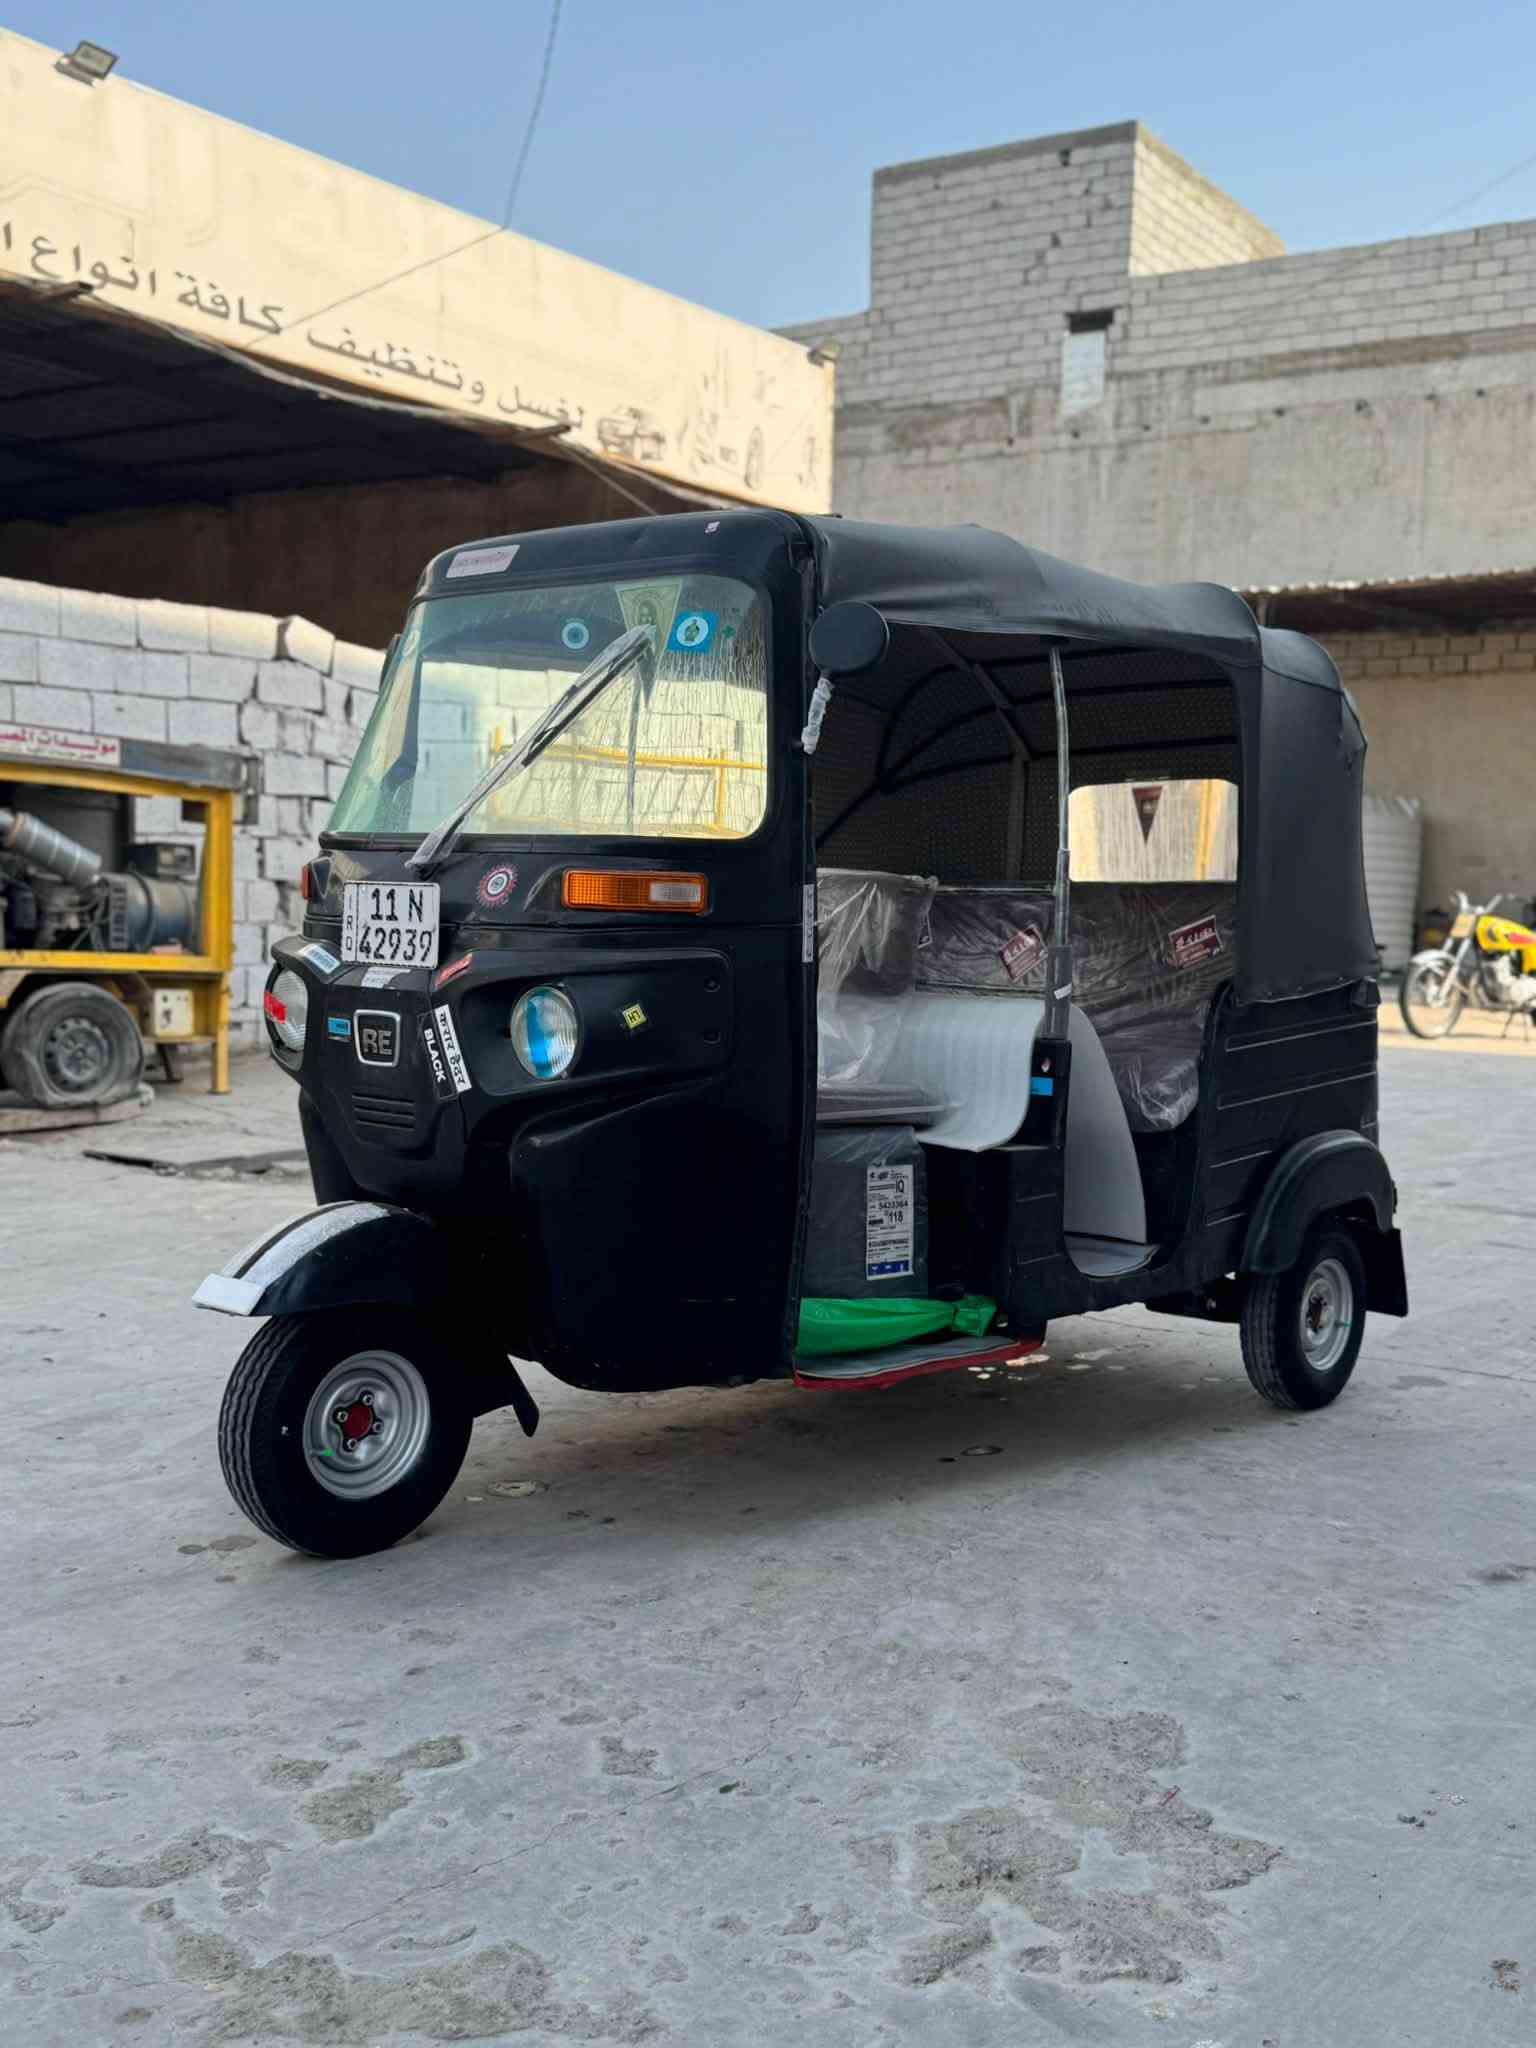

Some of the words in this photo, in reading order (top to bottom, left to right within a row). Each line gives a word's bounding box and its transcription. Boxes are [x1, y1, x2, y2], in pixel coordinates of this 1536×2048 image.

[177, 271, 283, 334] كافة
[370, 888, 398, 920] 11
[408, 888, 424, 922] N
[359, 926, 433, 961] 42939
[362, 1028, 393, 1055] RE
[424, 1028, 447, 1083] BLACK
